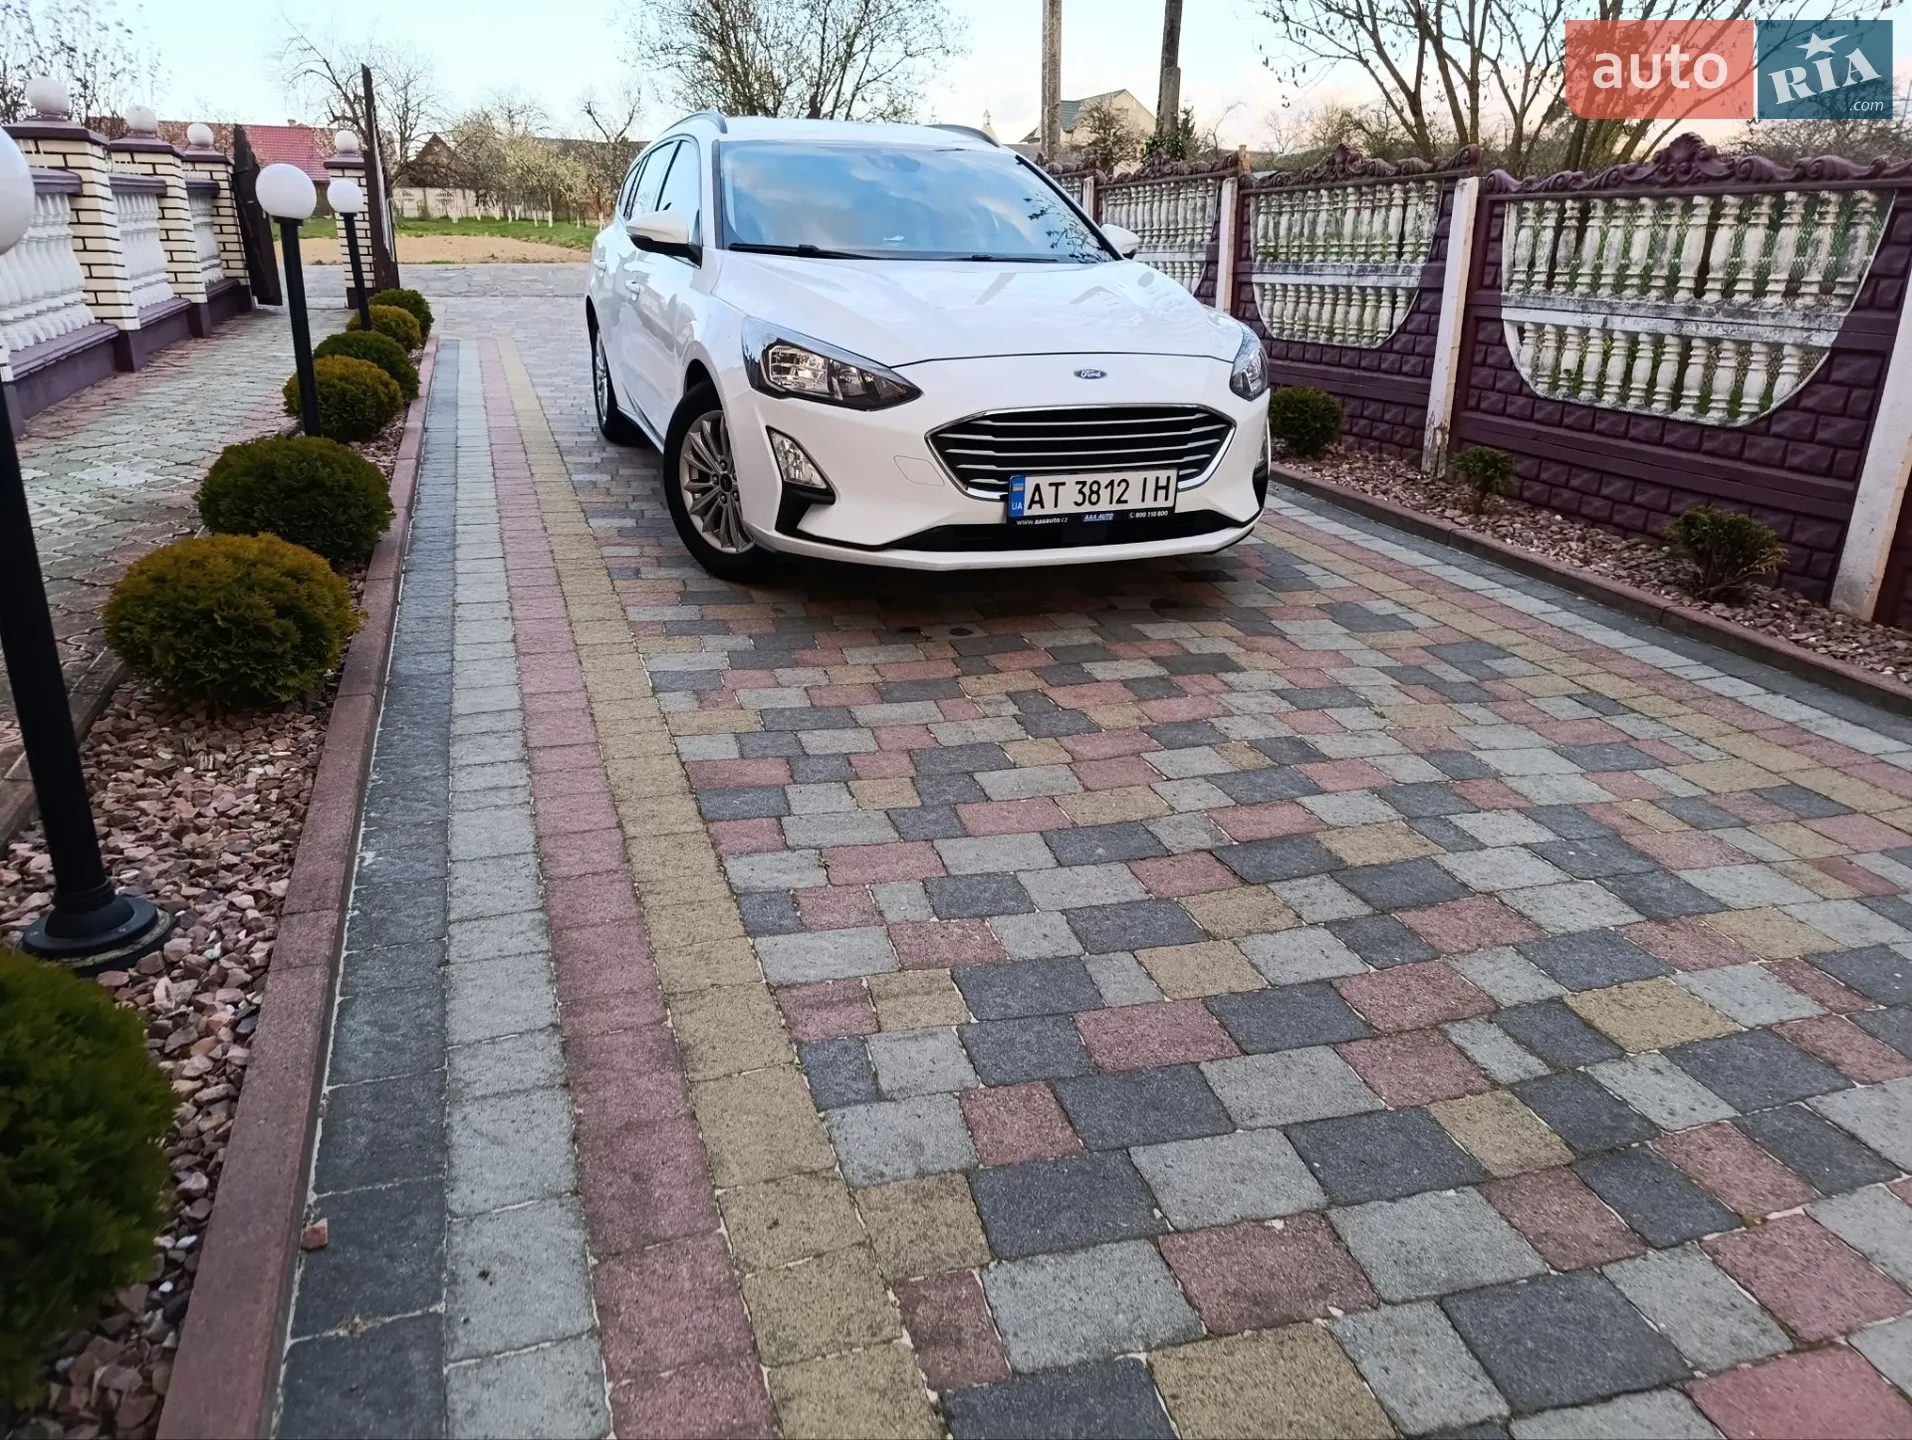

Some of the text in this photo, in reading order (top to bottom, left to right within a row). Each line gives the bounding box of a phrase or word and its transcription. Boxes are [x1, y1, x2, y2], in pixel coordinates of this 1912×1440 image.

[1027, 475, 1171, 510] AT 3812 IH
[1012, 501, 1023, 511] UA
[1083, 512, 1114, 522] AAA AUTO
